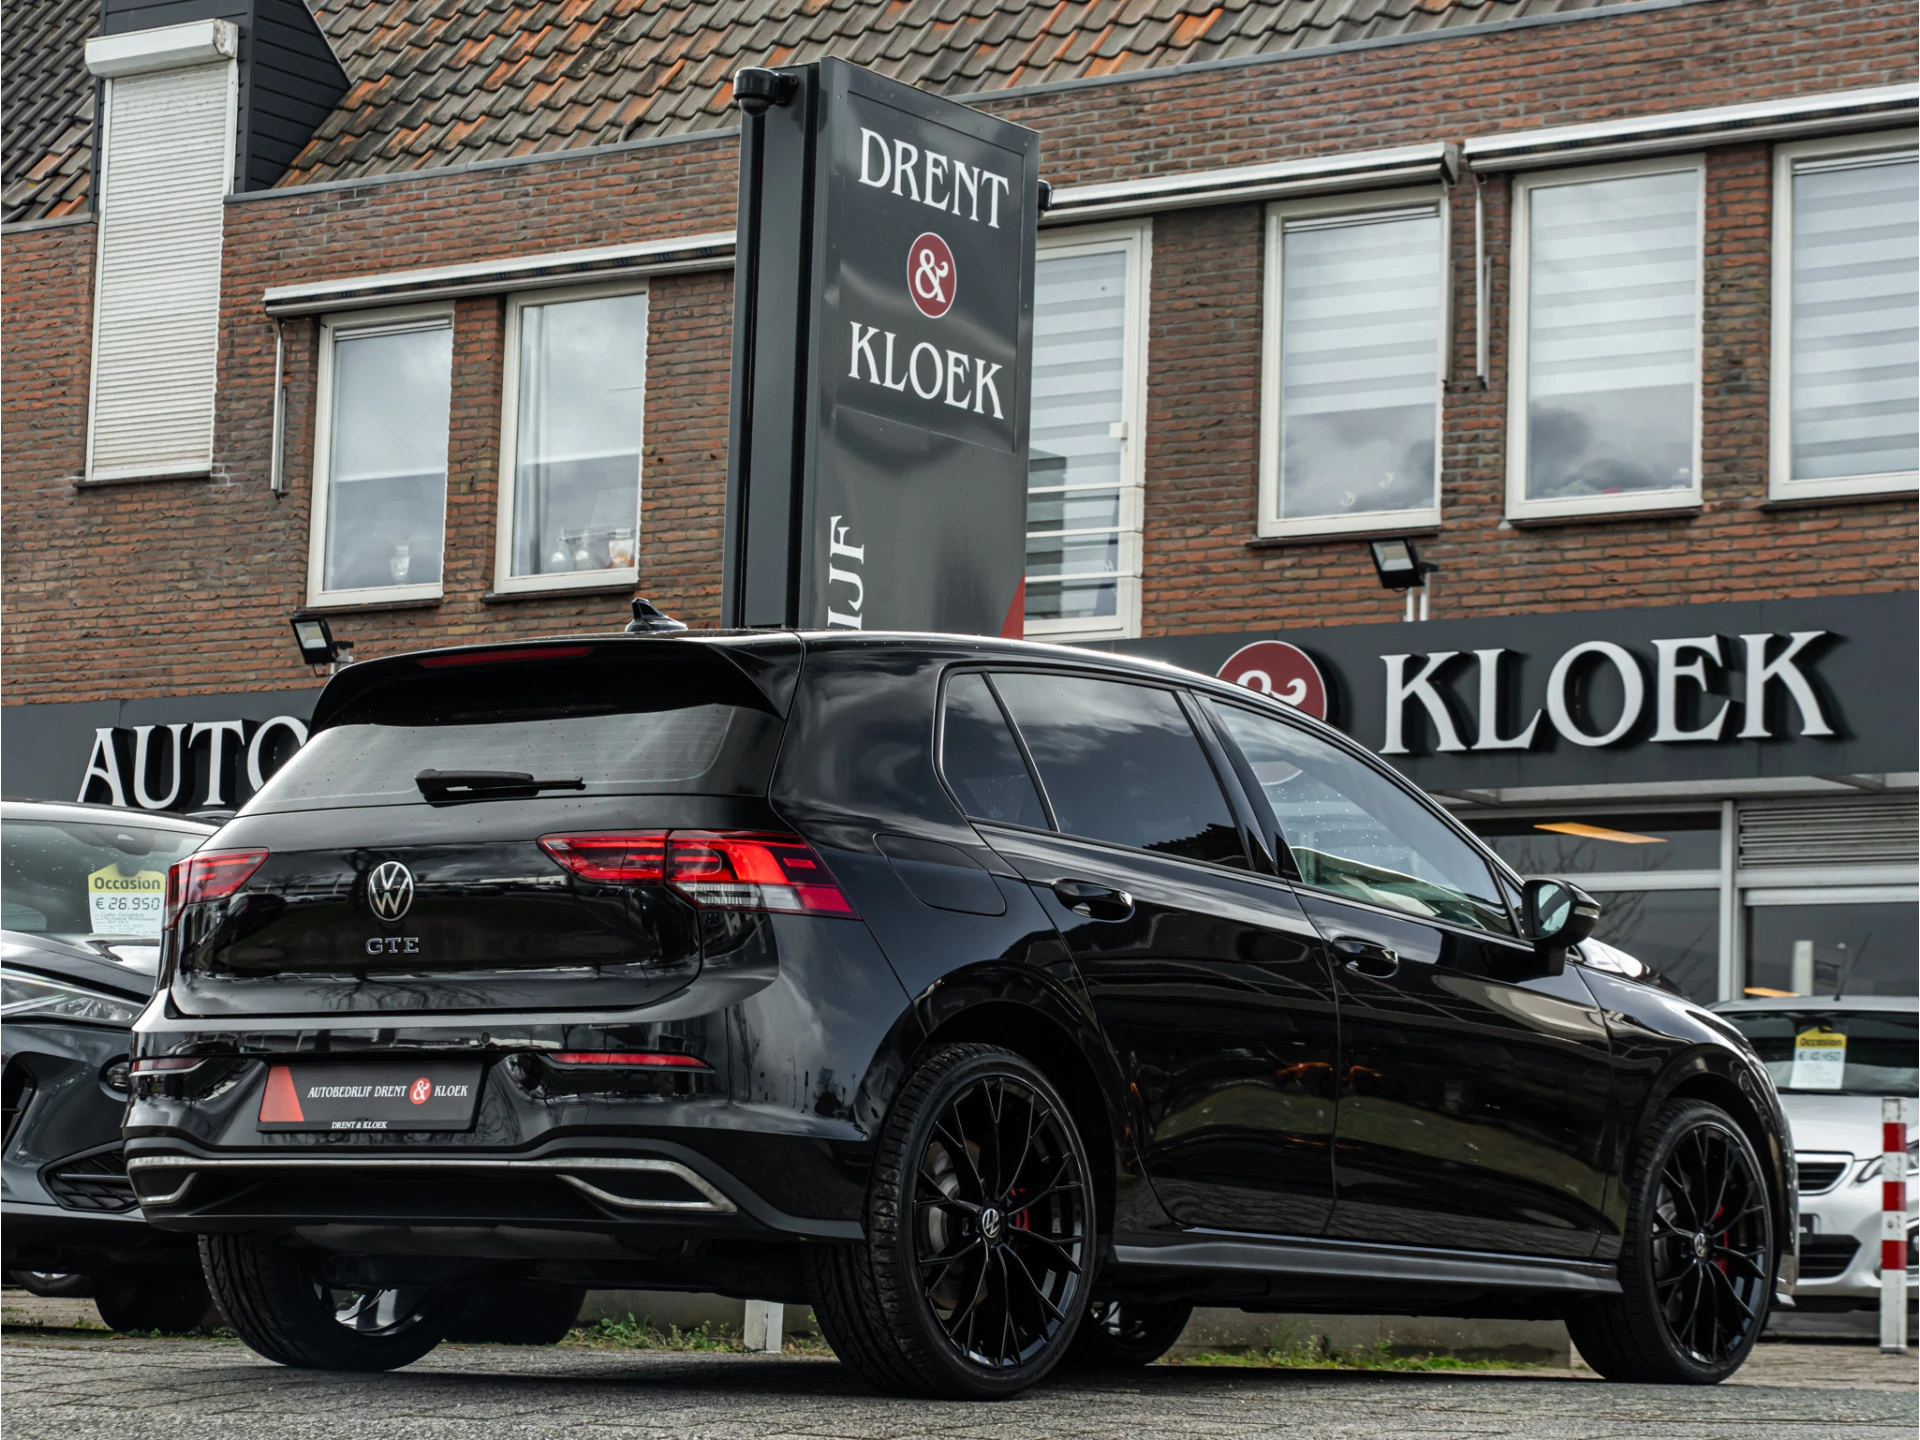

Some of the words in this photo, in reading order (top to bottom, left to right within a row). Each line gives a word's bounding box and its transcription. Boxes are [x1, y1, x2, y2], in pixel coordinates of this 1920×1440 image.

[858, 127, 1010, 230] DRENT
[915, 248, 949, 303] &
[848, 321, 1005, 420] KLOEK
[1379, 630, 1835, 754] KLOEK
[94, 876, 161, 890] Occasion
[108, 897, 161, 911] 26.950
[365, 937, 419, 955] GTE
[308, 1086, 373, 1098] AUTOBEDRIJF
[374, 1086, 407, 1097] DRENT
[413, 1080, 430, 1100] &
[434, 1085, 469, 1097] KLOEK
[332, 1121, 356, 1129] DRENT
[362, 1121, 388, 1129] KLOEK
